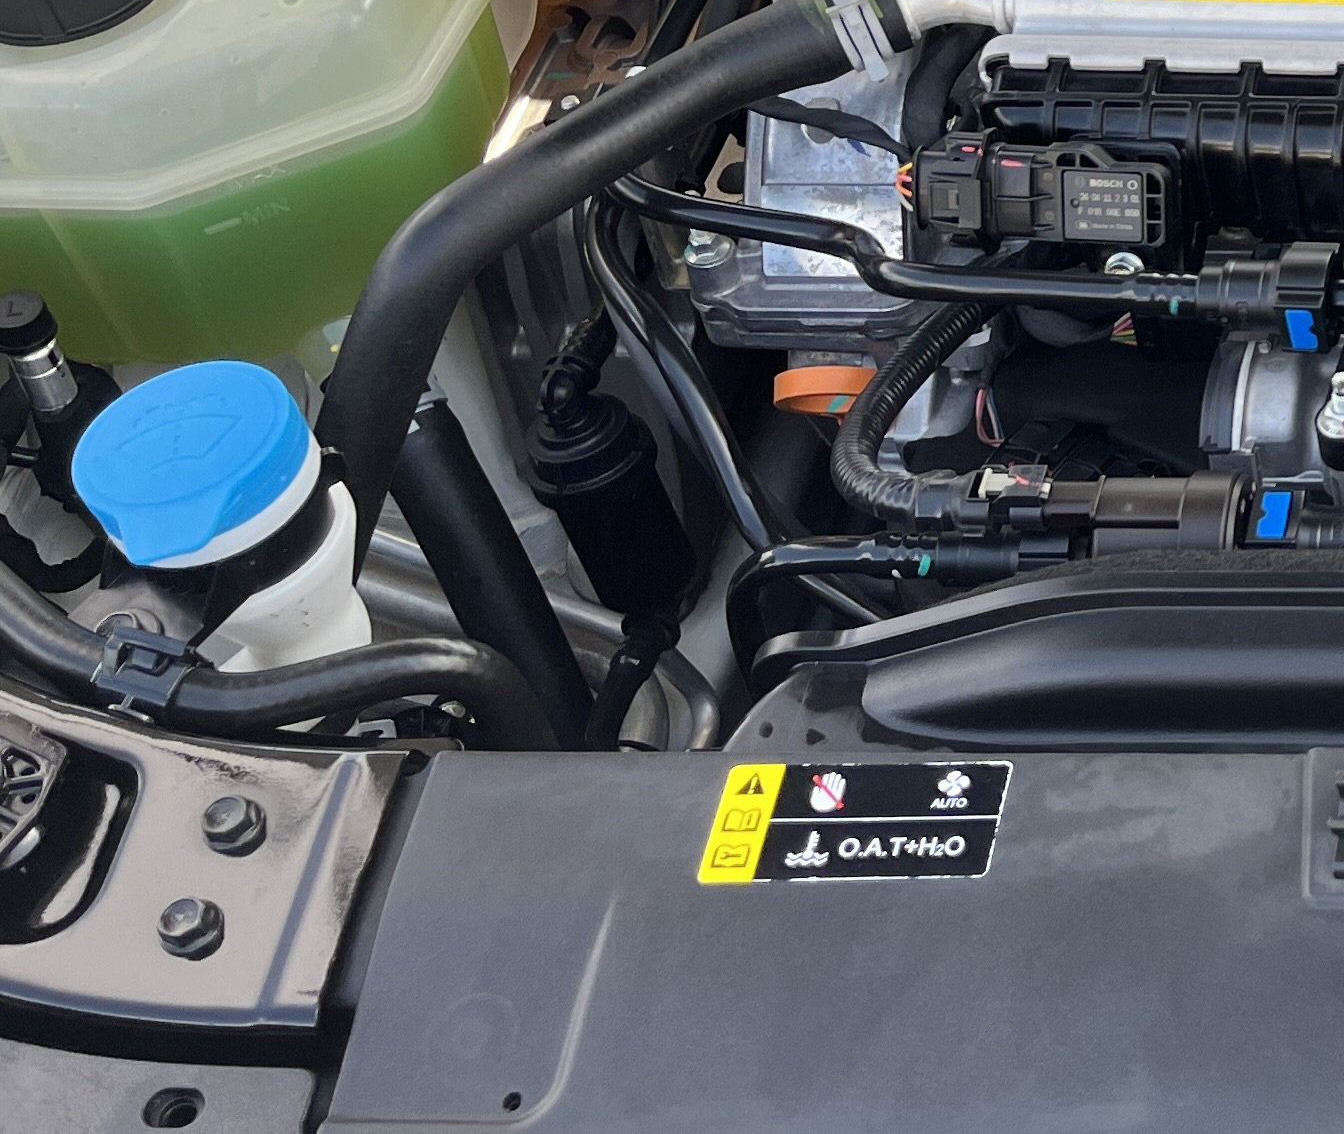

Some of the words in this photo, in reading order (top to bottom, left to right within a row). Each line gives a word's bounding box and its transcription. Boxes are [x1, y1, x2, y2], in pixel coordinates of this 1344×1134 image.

[1089, 178, 1124, 189] BOSCH
[242, 197, 292, 225] MIN
[931, 796, 968, 809] AUTO
